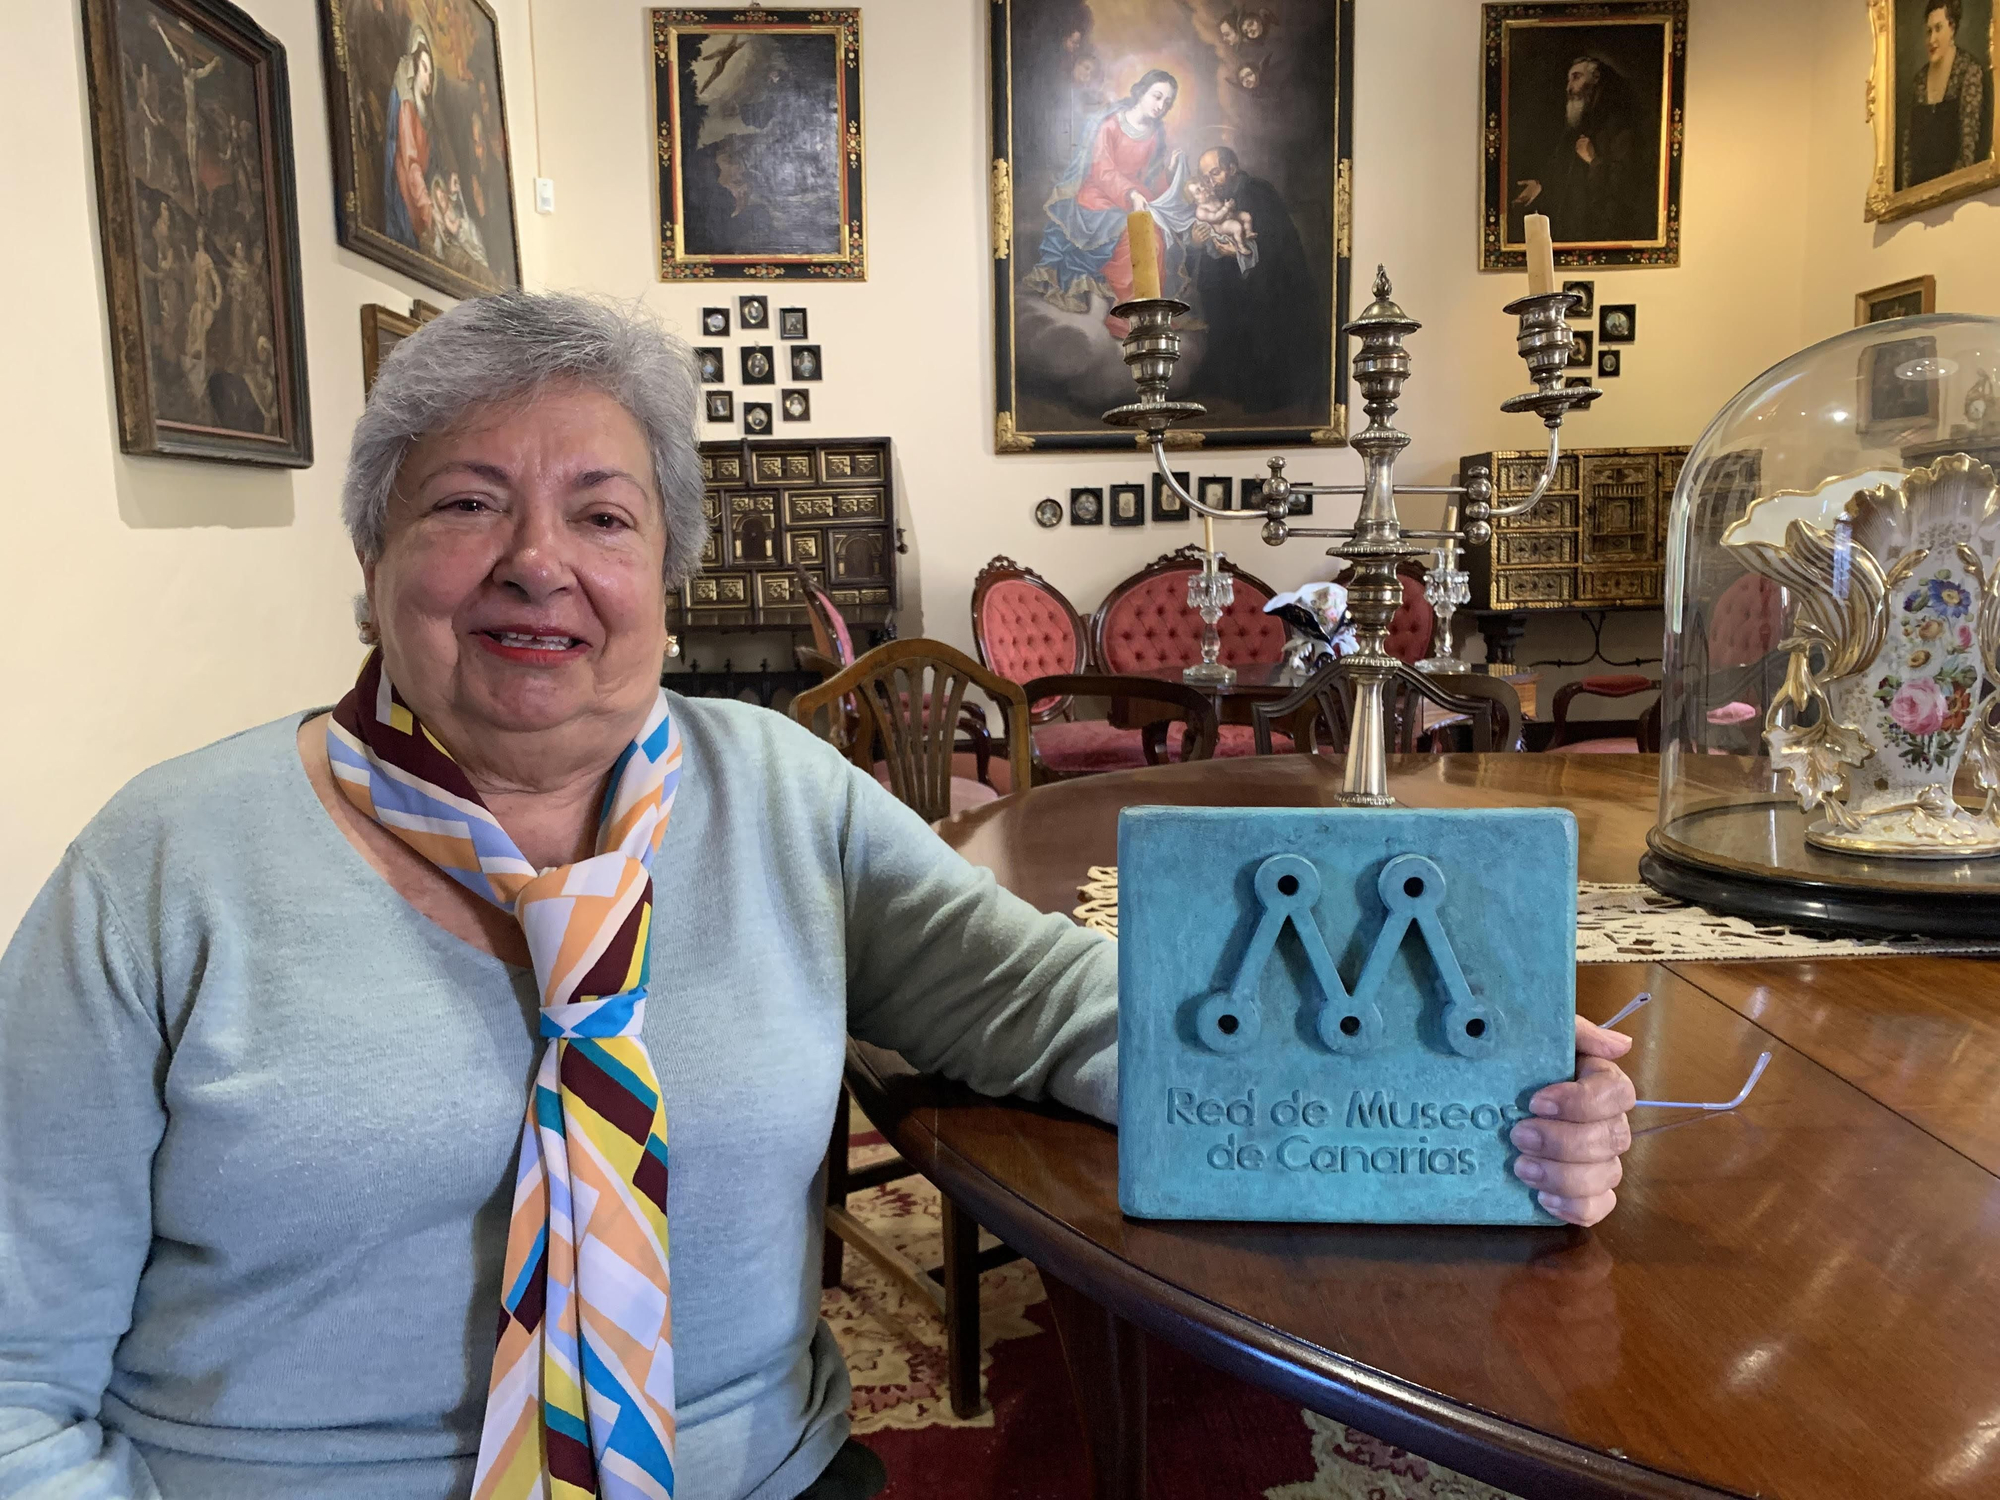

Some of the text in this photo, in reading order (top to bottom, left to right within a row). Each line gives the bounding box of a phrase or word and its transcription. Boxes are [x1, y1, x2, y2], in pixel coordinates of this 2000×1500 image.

[1166, 1087, 1256, 1126] Red
[1270, 1089, 1332, 1128] de
[1206, 1133, 1478, 1175] de Canarias
